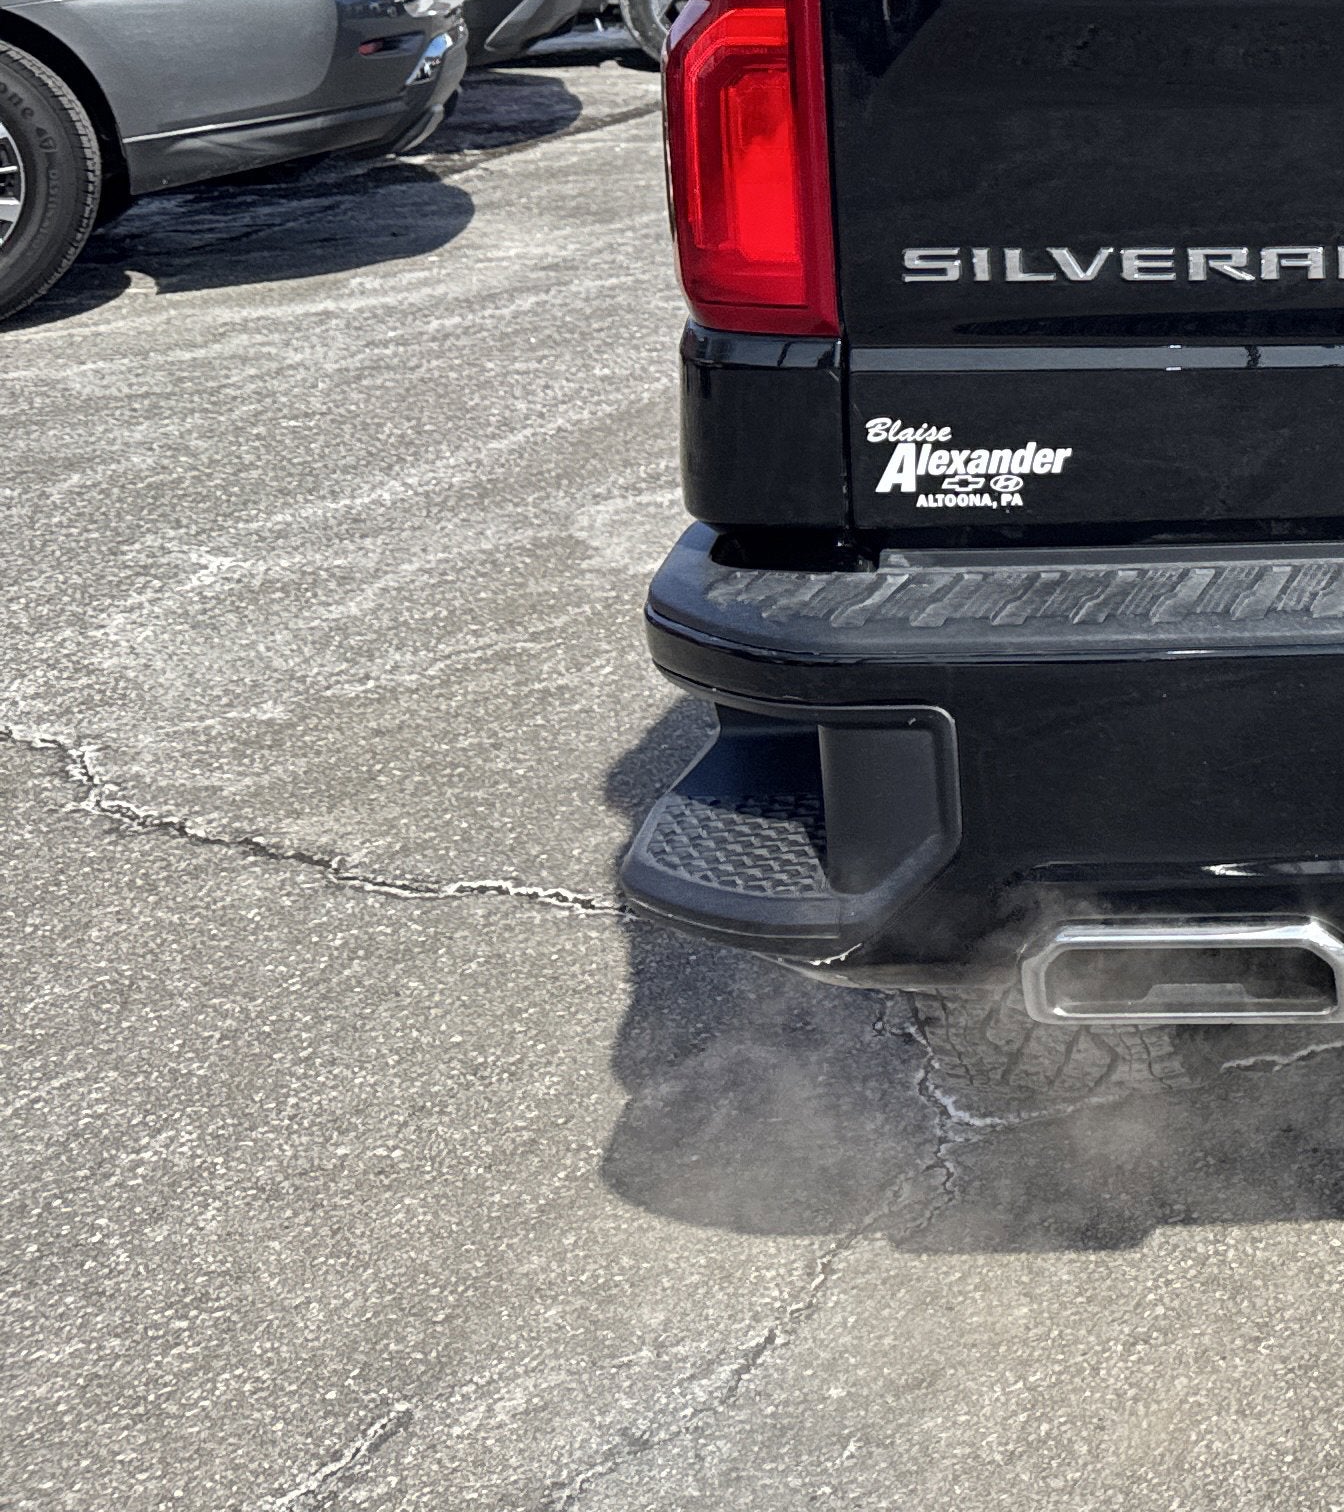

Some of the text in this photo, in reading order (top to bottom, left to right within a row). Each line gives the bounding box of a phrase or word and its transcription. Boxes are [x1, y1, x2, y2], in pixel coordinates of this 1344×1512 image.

[865, 417, 952, 443] Blaise
[875, 441, 1073, 493] Alexander
[916, 492, 1024, 509] ALTOONA, PA
